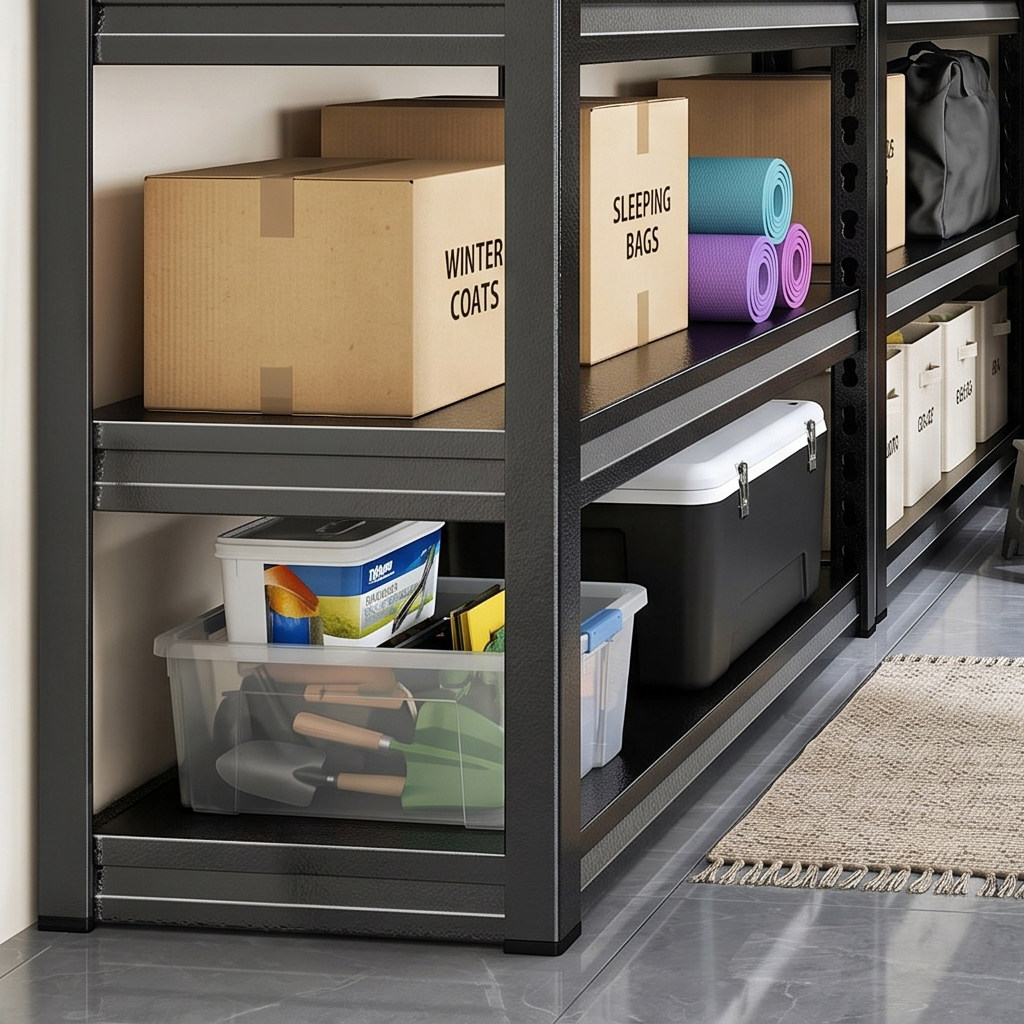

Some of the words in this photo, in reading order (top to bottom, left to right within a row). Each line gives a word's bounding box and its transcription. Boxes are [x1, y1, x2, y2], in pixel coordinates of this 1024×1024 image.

[613, 185, 671, 224] SLEEPING
[444, 238, 503, 280] WINTER
[626, 226, 659, 260] BAGS
[450, 279, 499, 321] COATS
